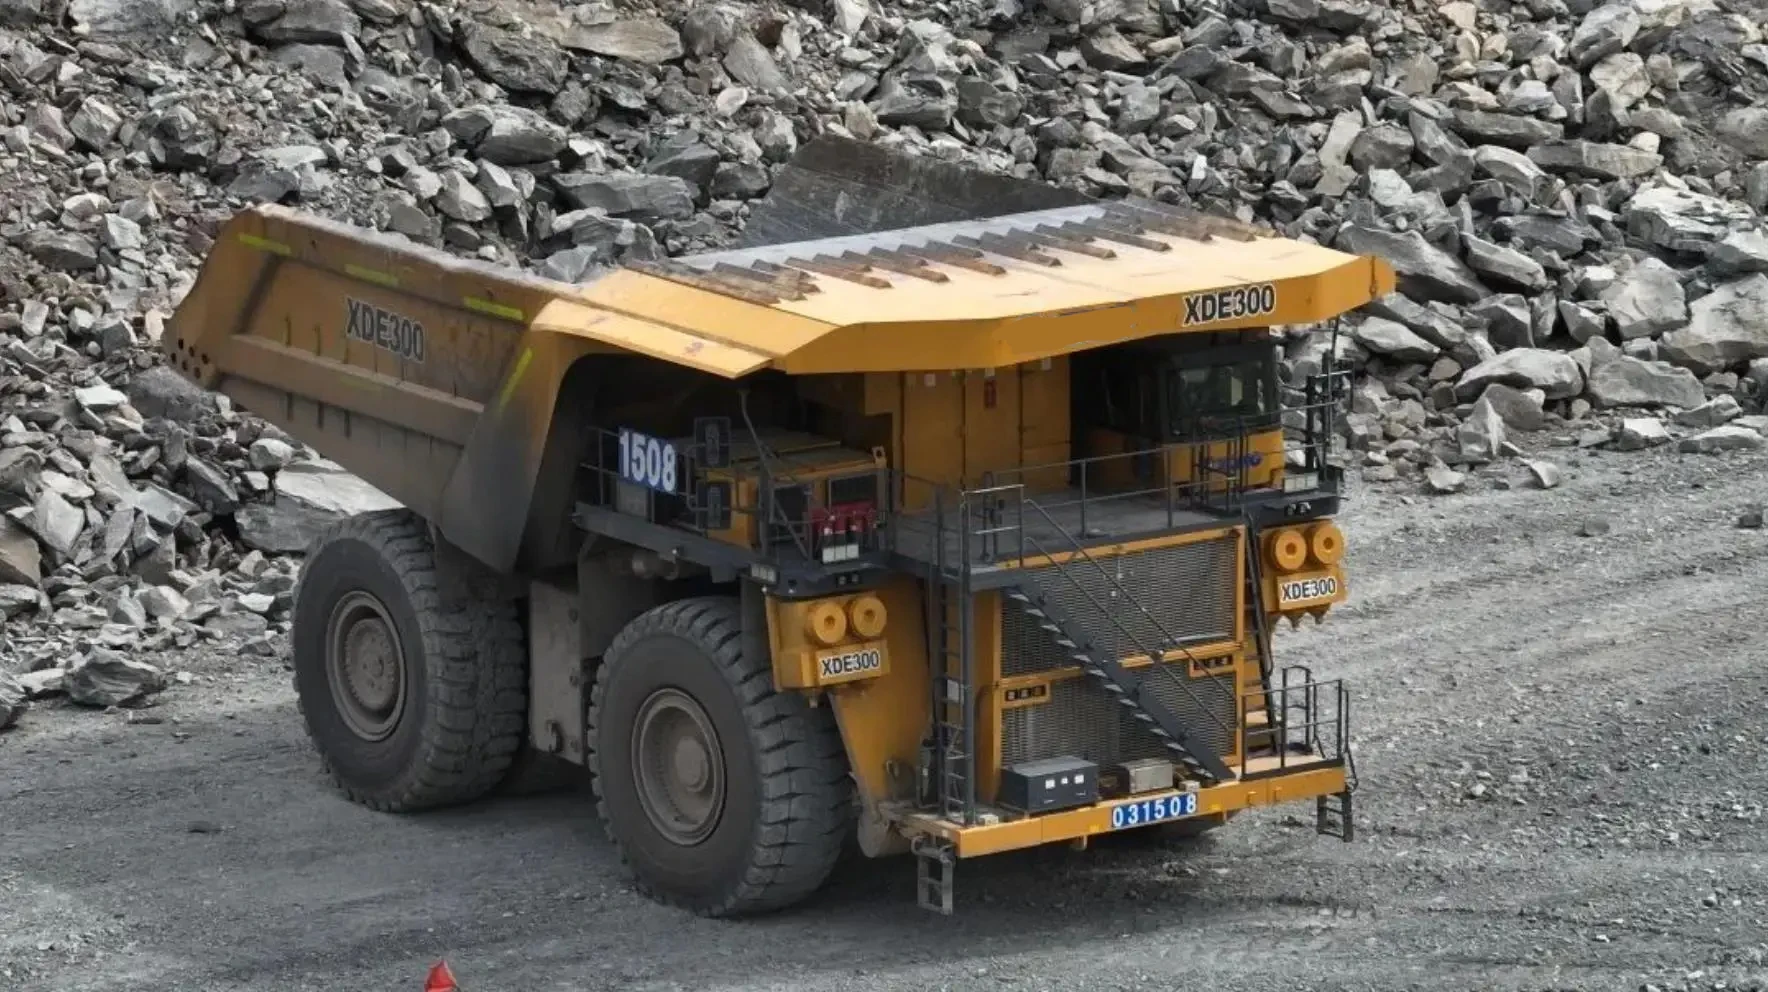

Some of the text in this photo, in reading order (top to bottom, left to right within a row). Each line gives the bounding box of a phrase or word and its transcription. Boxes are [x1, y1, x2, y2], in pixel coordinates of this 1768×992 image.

[1183, 283, 1276, 326] XDE300
[346, 298, 424, 362] XDE300
[619, 432, 677, 493] 1508
[1280, 577, 1337, 603] XDE300
[820, 650, 880, 677] XDE300
